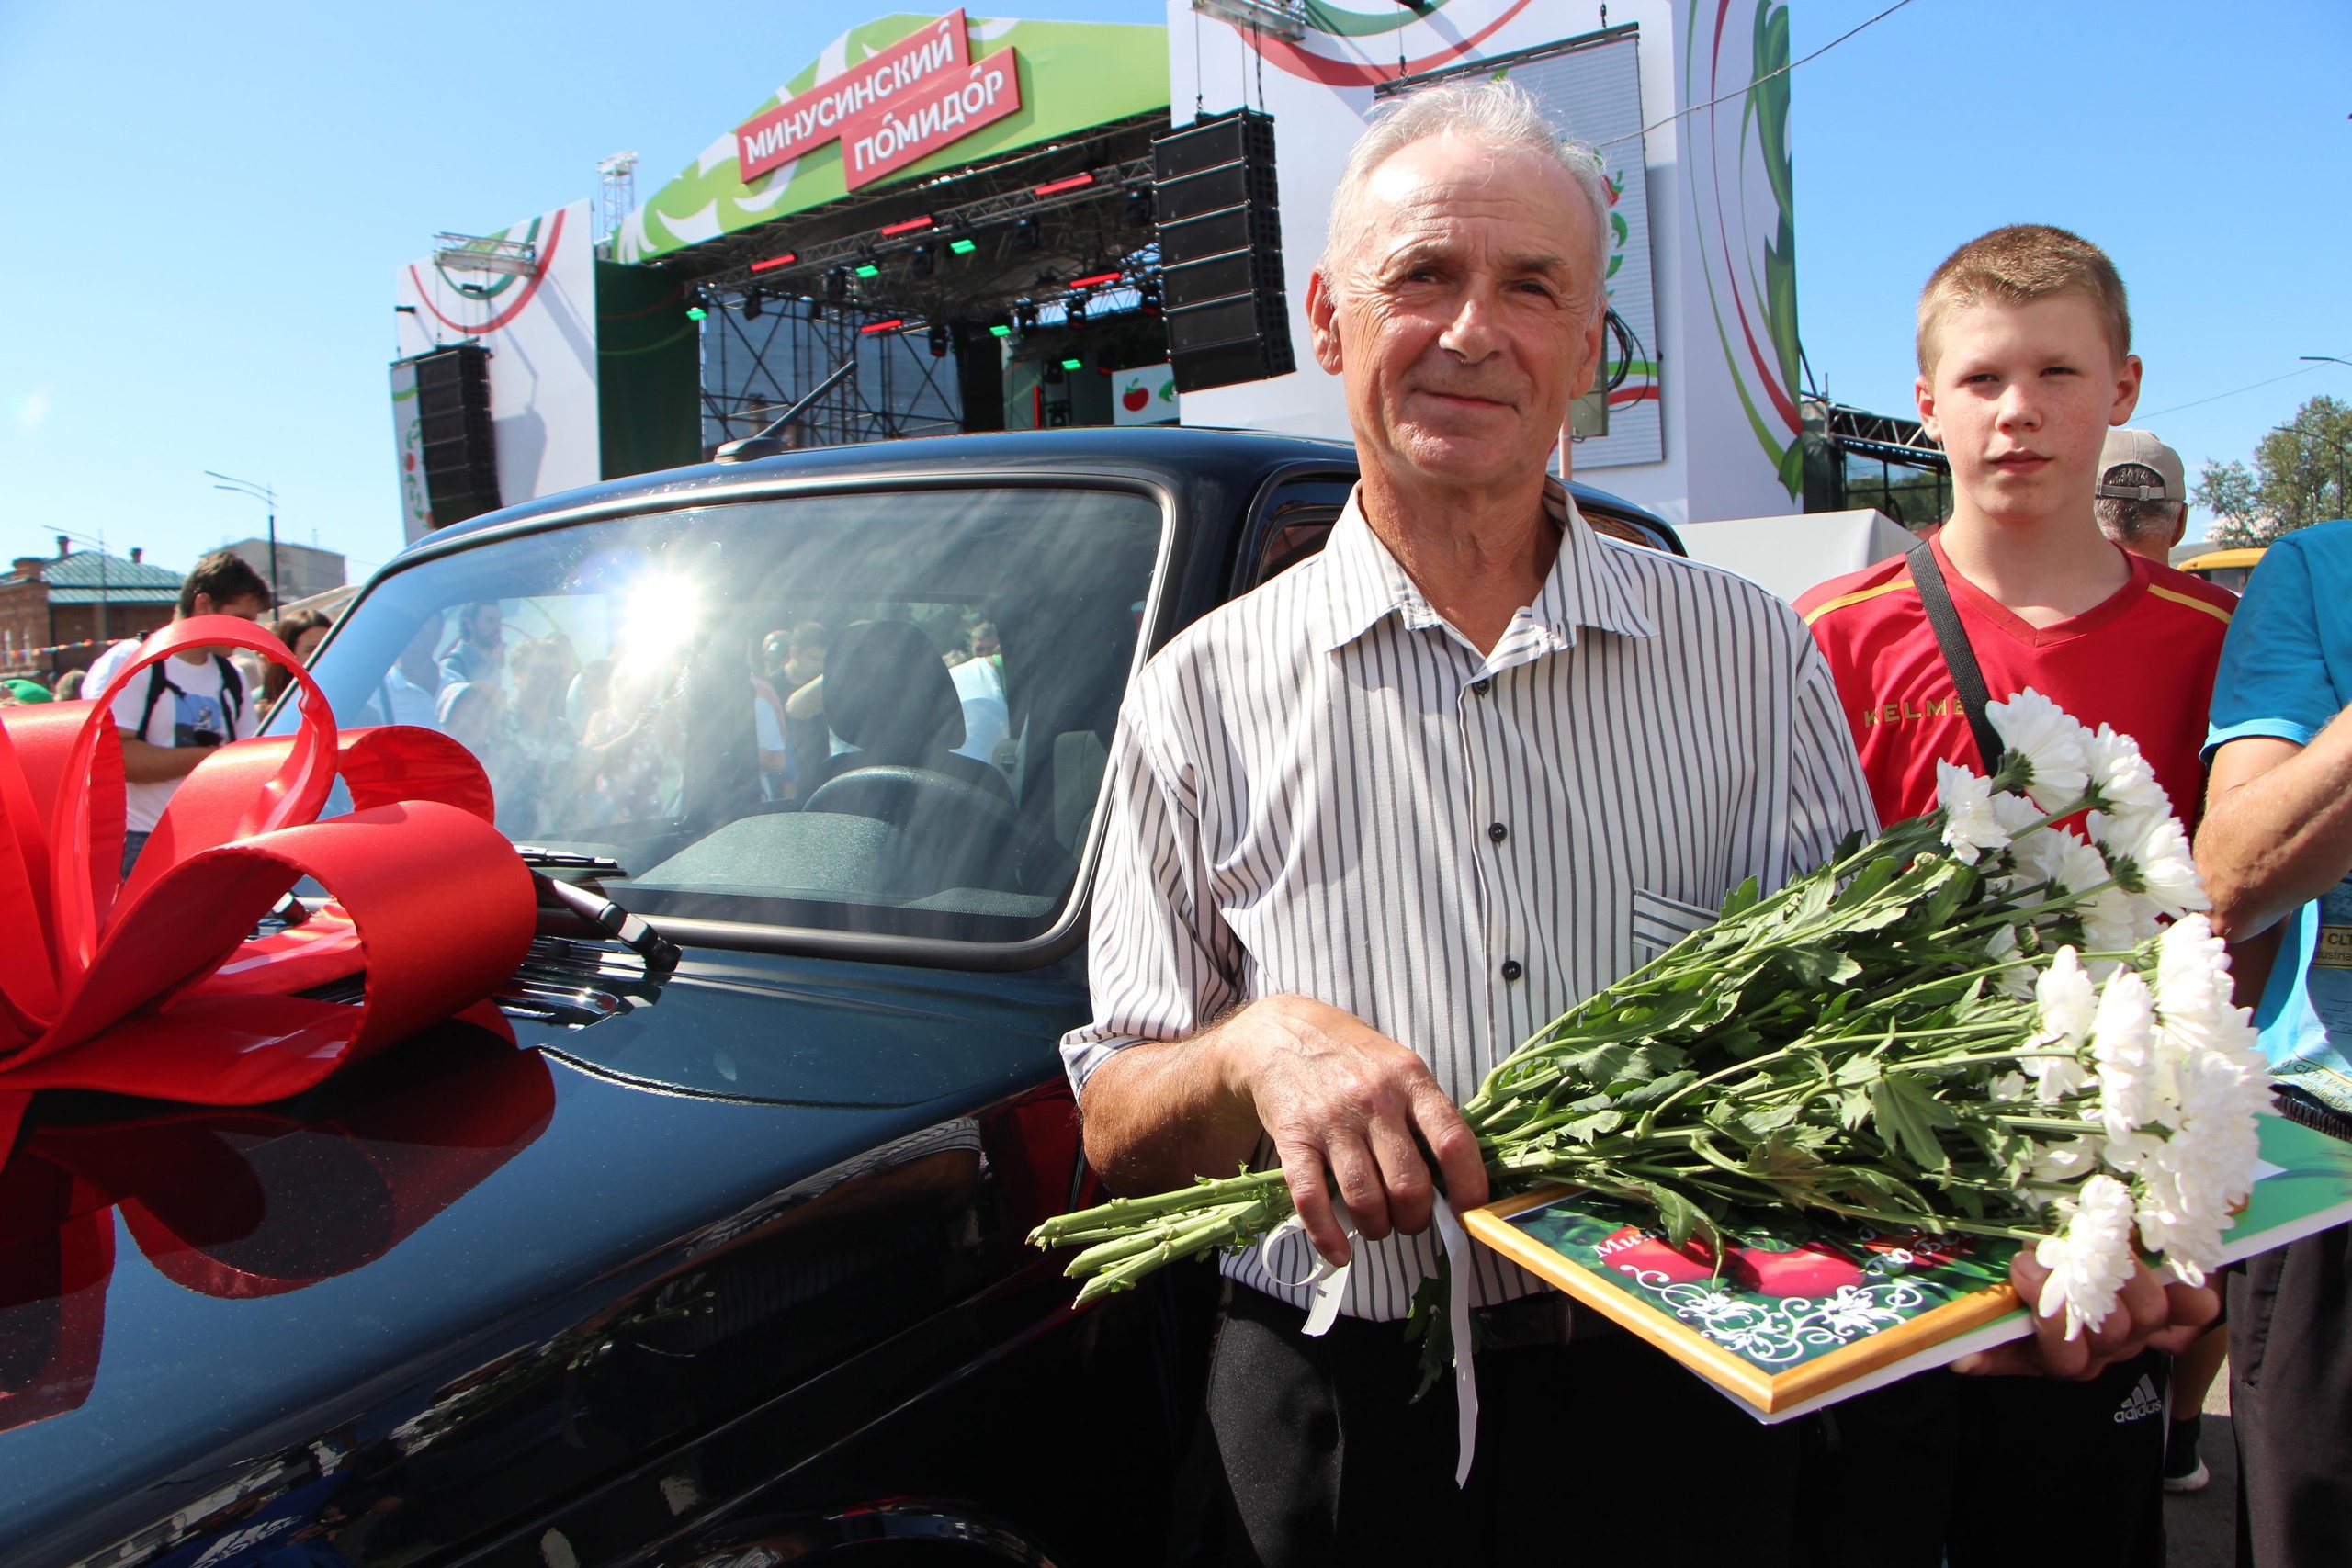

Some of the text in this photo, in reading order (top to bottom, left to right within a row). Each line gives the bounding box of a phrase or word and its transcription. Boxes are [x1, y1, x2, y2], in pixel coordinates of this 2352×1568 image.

[742, 19, 955, 164] МИНУСИНСКИЙ
[1863, 698, 1966, 728] KELME
[2113, 1399, 2162, 1423] adidas
